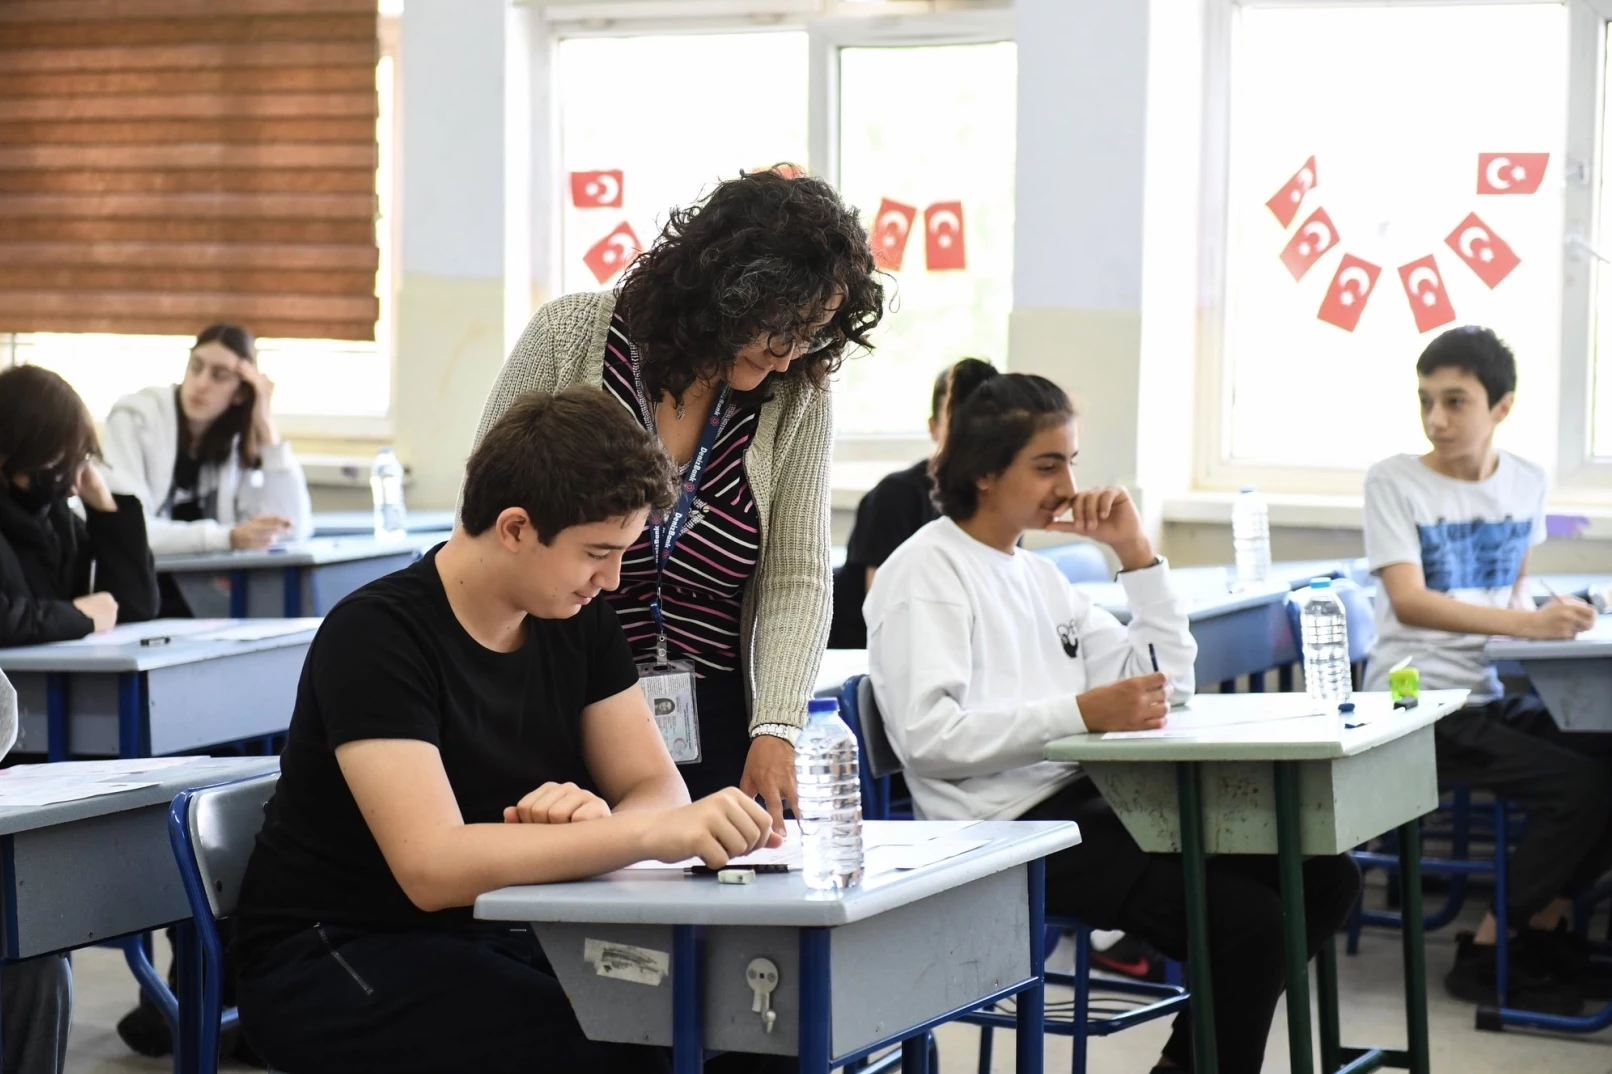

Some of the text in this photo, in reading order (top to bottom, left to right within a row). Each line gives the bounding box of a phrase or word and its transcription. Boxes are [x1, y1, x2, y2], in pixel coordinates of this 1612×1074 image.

[714, 384, 729, 416] nizBank
[689, 446, 708, 482] DenizBank
[664, 512, 683, 549] DenizBank
